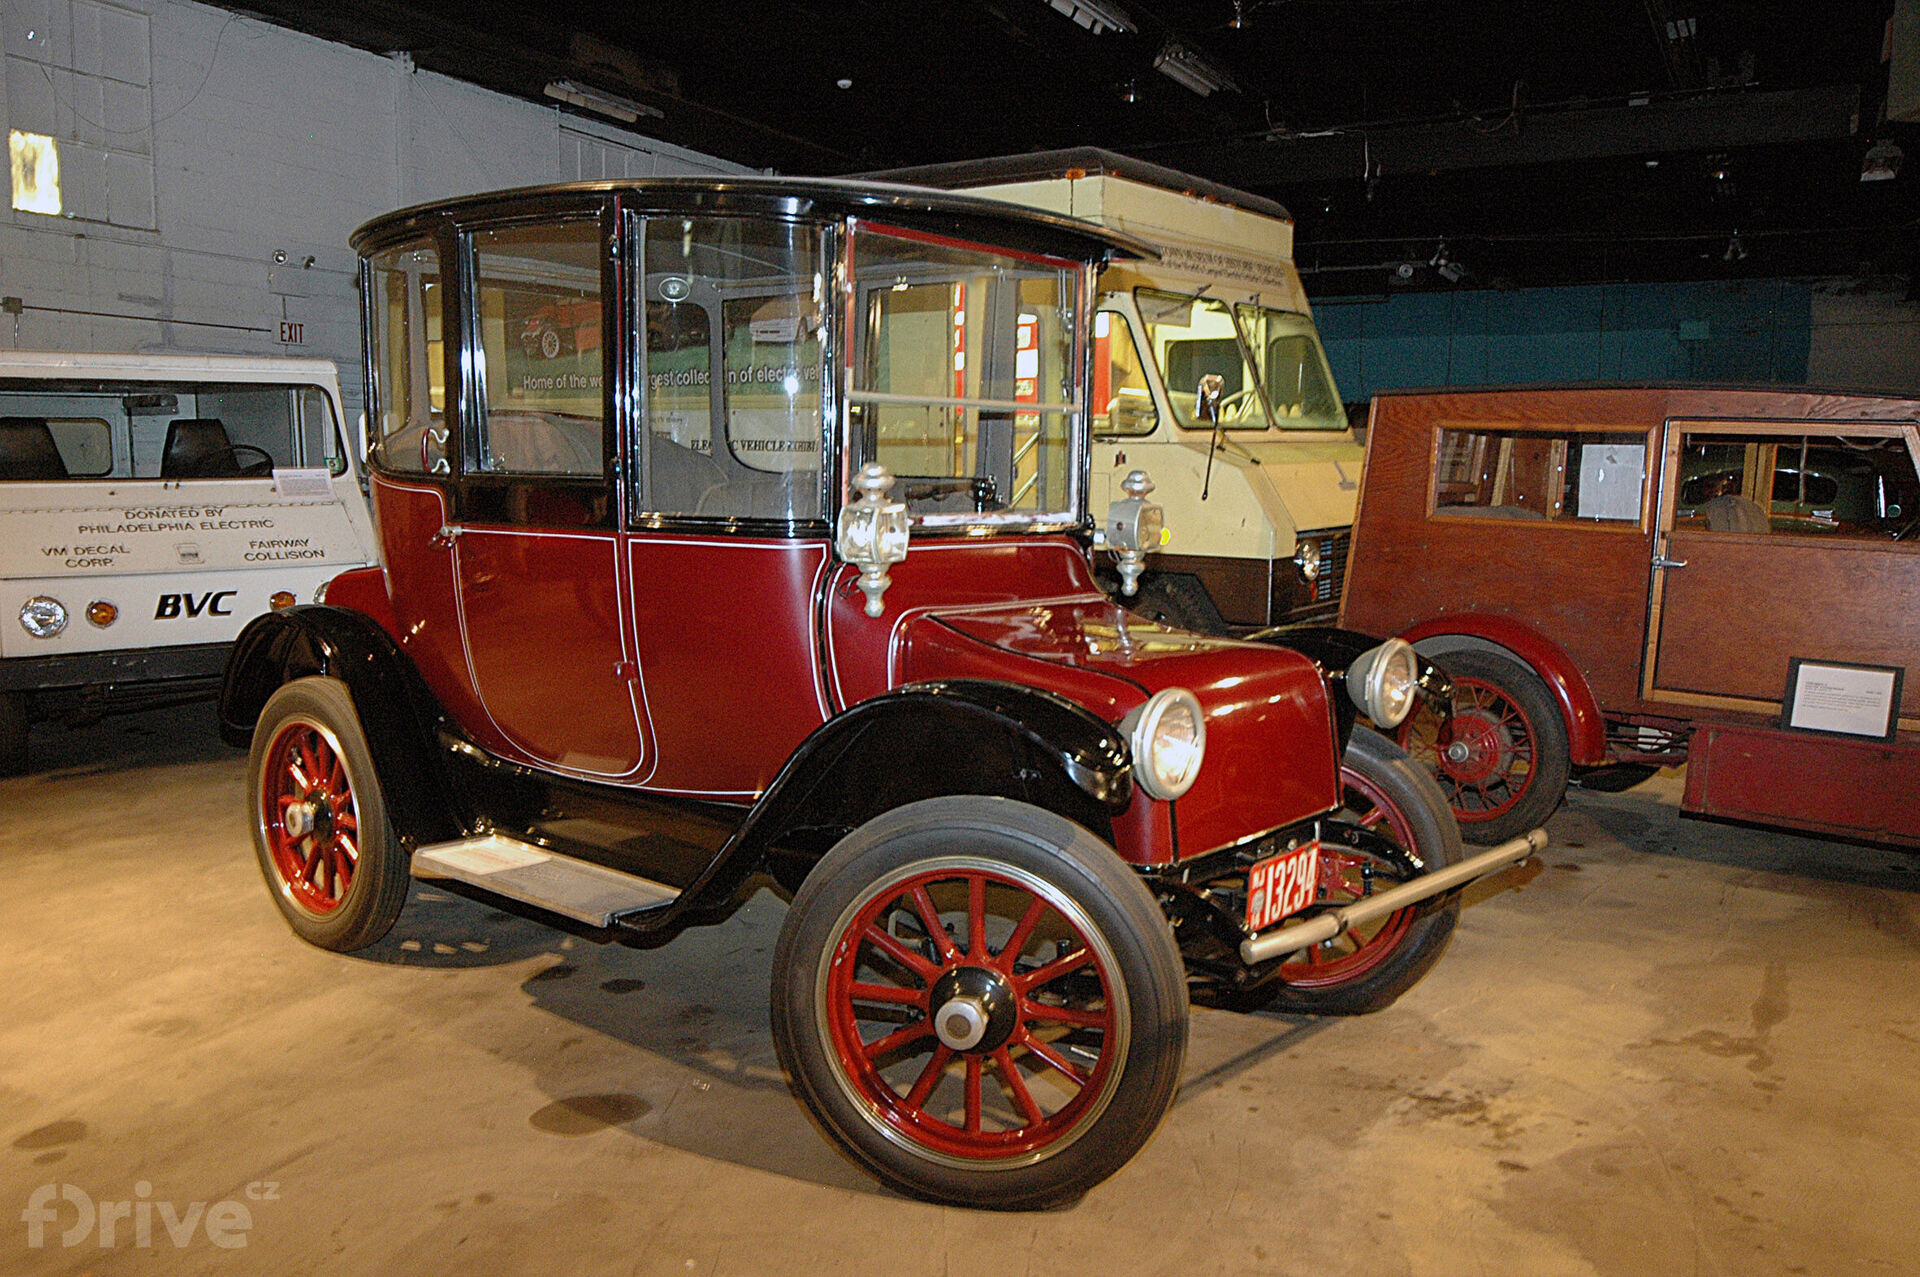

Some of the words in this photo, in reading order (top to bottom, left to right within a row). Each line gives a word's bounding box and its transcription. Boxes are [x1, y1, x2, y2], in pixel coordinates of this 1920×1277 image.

[280, 321, 304, 344] EXIT
[523, 375, 553, 390] Home
[556, 374, 567, 389] of
[569, 374, 587, 389] the
[740, 366, 753, 382] of
[741, 440, 785, 452] VEHICLE
[124, 509, 200, 520] DONATED
[205, 508, 224, 518] BY
[78, 523, 194, 535] PHILADELPHIA
[200, 519, 275, 531] ELECTRIC
[249, 538, 311, 549] FAIRWAY
[41, 547, 67, 557] VM
[74, 544, 131, 556] DECAL
[243, 549, 325, 562] COLLISION
[65, 558, 115, 568] CORP.
[154, 591, 238, 620] BVC
[1264, 847, 1319, 925] 13294
